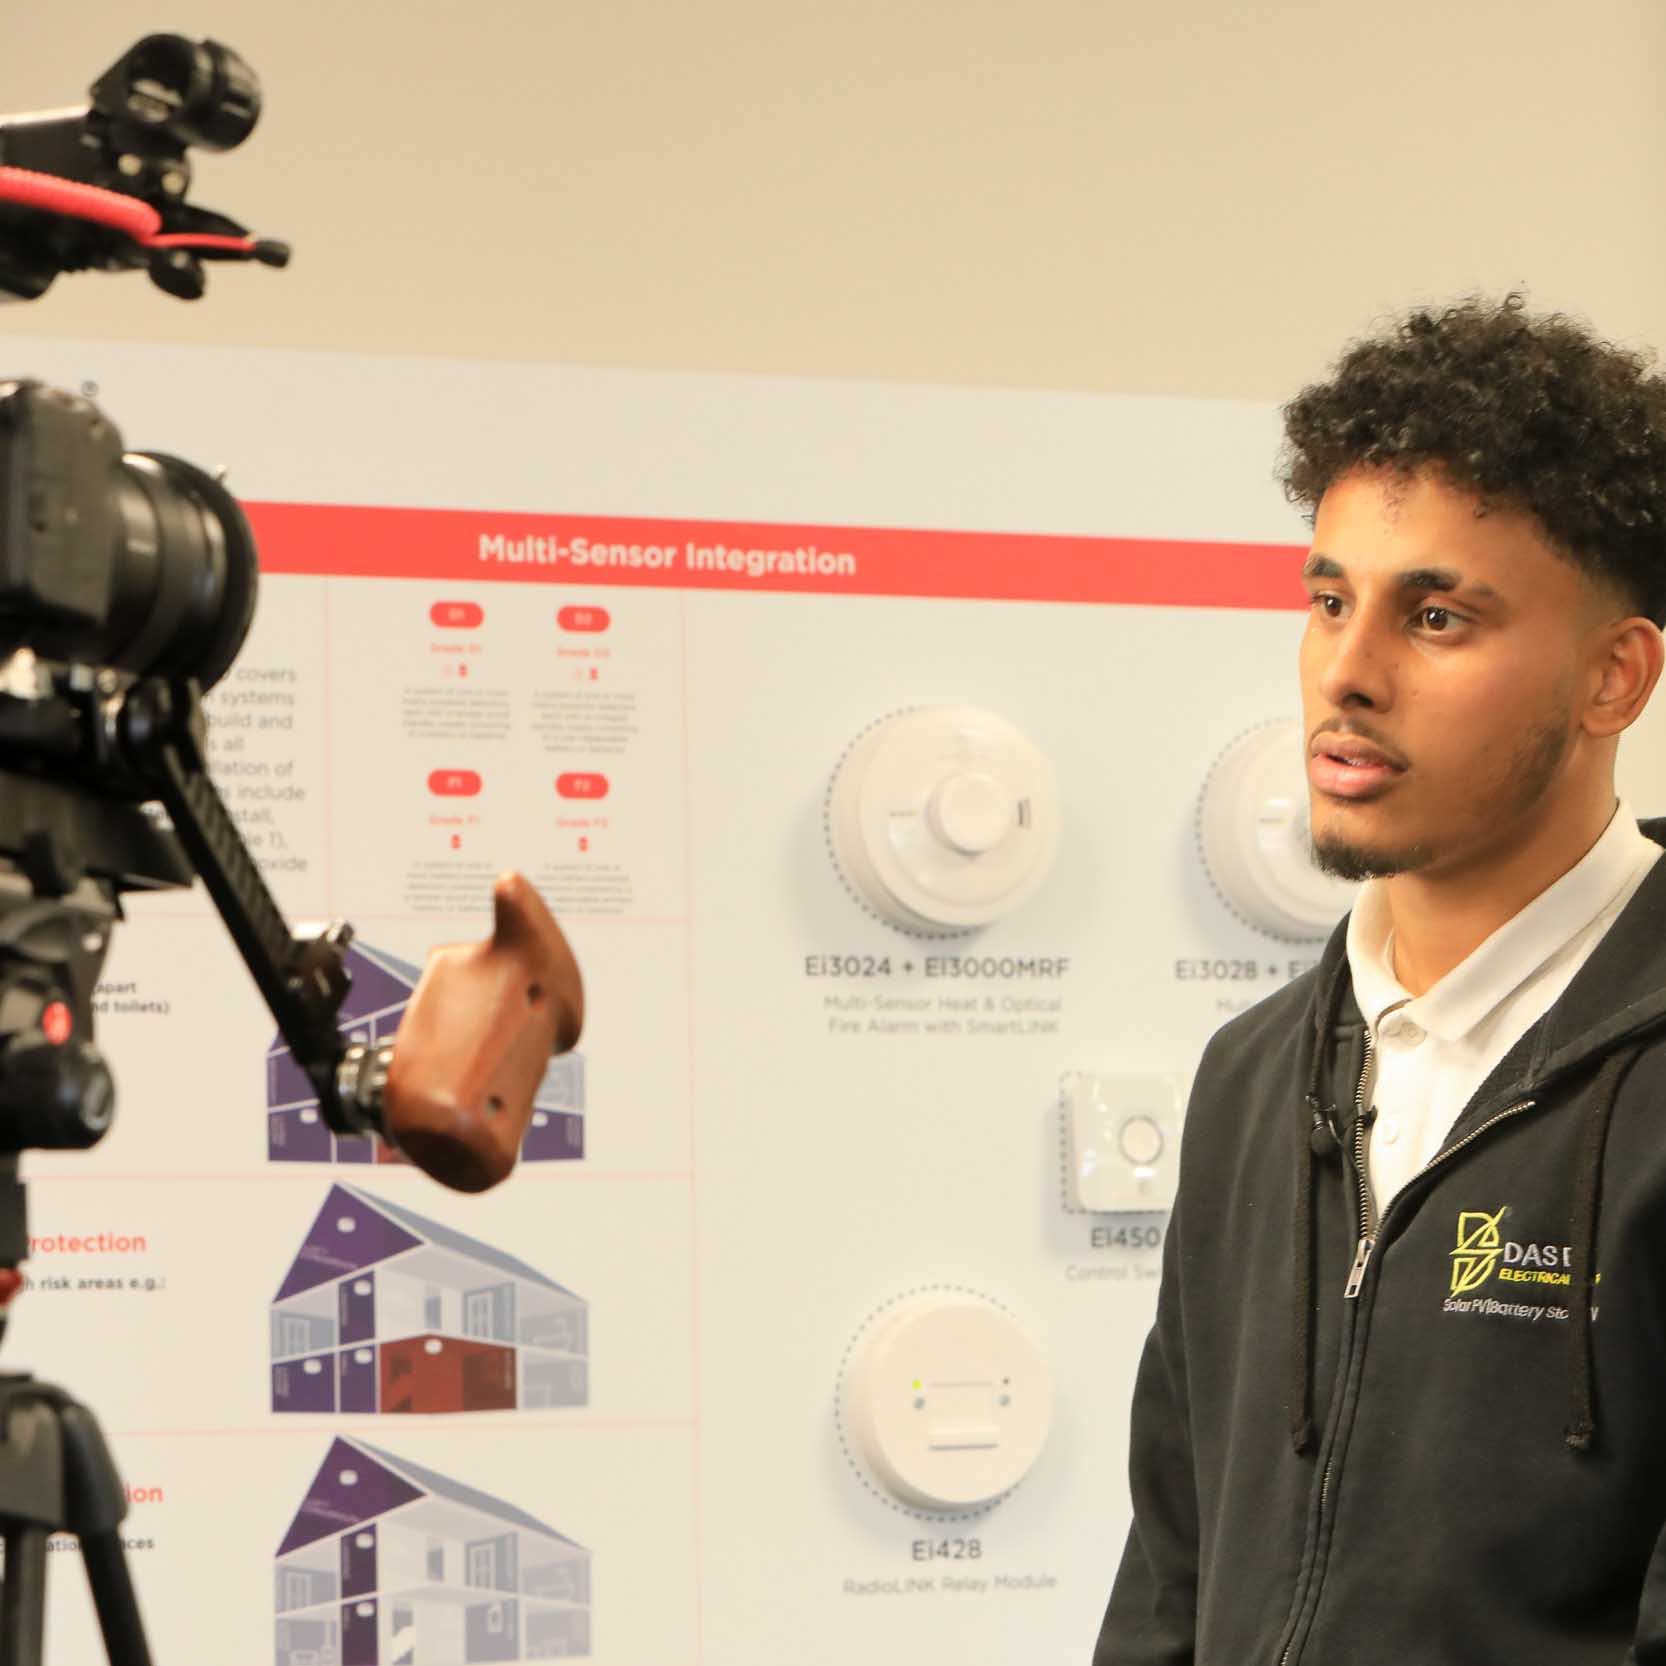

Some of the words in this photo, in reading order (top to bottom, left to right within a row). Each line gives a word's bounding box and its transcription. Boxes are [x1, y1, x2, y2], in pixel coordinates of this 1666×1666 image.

[478, 534, 677, 569] Multi-Sensor
[685, 542, 857, 578] Integration
[235, 668, 298, 682] covers
[220, 690, 296, 708] systems
[257, 714, 294, 731] and
[237, 785, 306, 802] include
[804, 955, 893, 978] Ei3024
[924, 956, 1071, 979] Ei3000MRF
[114, 1001, 170, 1014] toilets)
[823, 996, 931, 1012] Multi-Sensor
[938, 997, 977, 1012] Heat
[1001, 997, 1062, 1014] Optical
[828, 1018, 861, 1033] Fire
[866, 1019, 920, 1033] Alarm
[925, 1019, 961, 1033] with
[29, 1231, 147, 1253] rotection
[40, 1276, 71, 1290] risk
[78, 1277, 124, 1290] areas
[1442, 1298, 1472, 1313] Solar
[911, 1538, 984, 1561] Ei428
[941, 1576, 988, 1594] Relay
[994, 1573, 1058, 1590] Module
